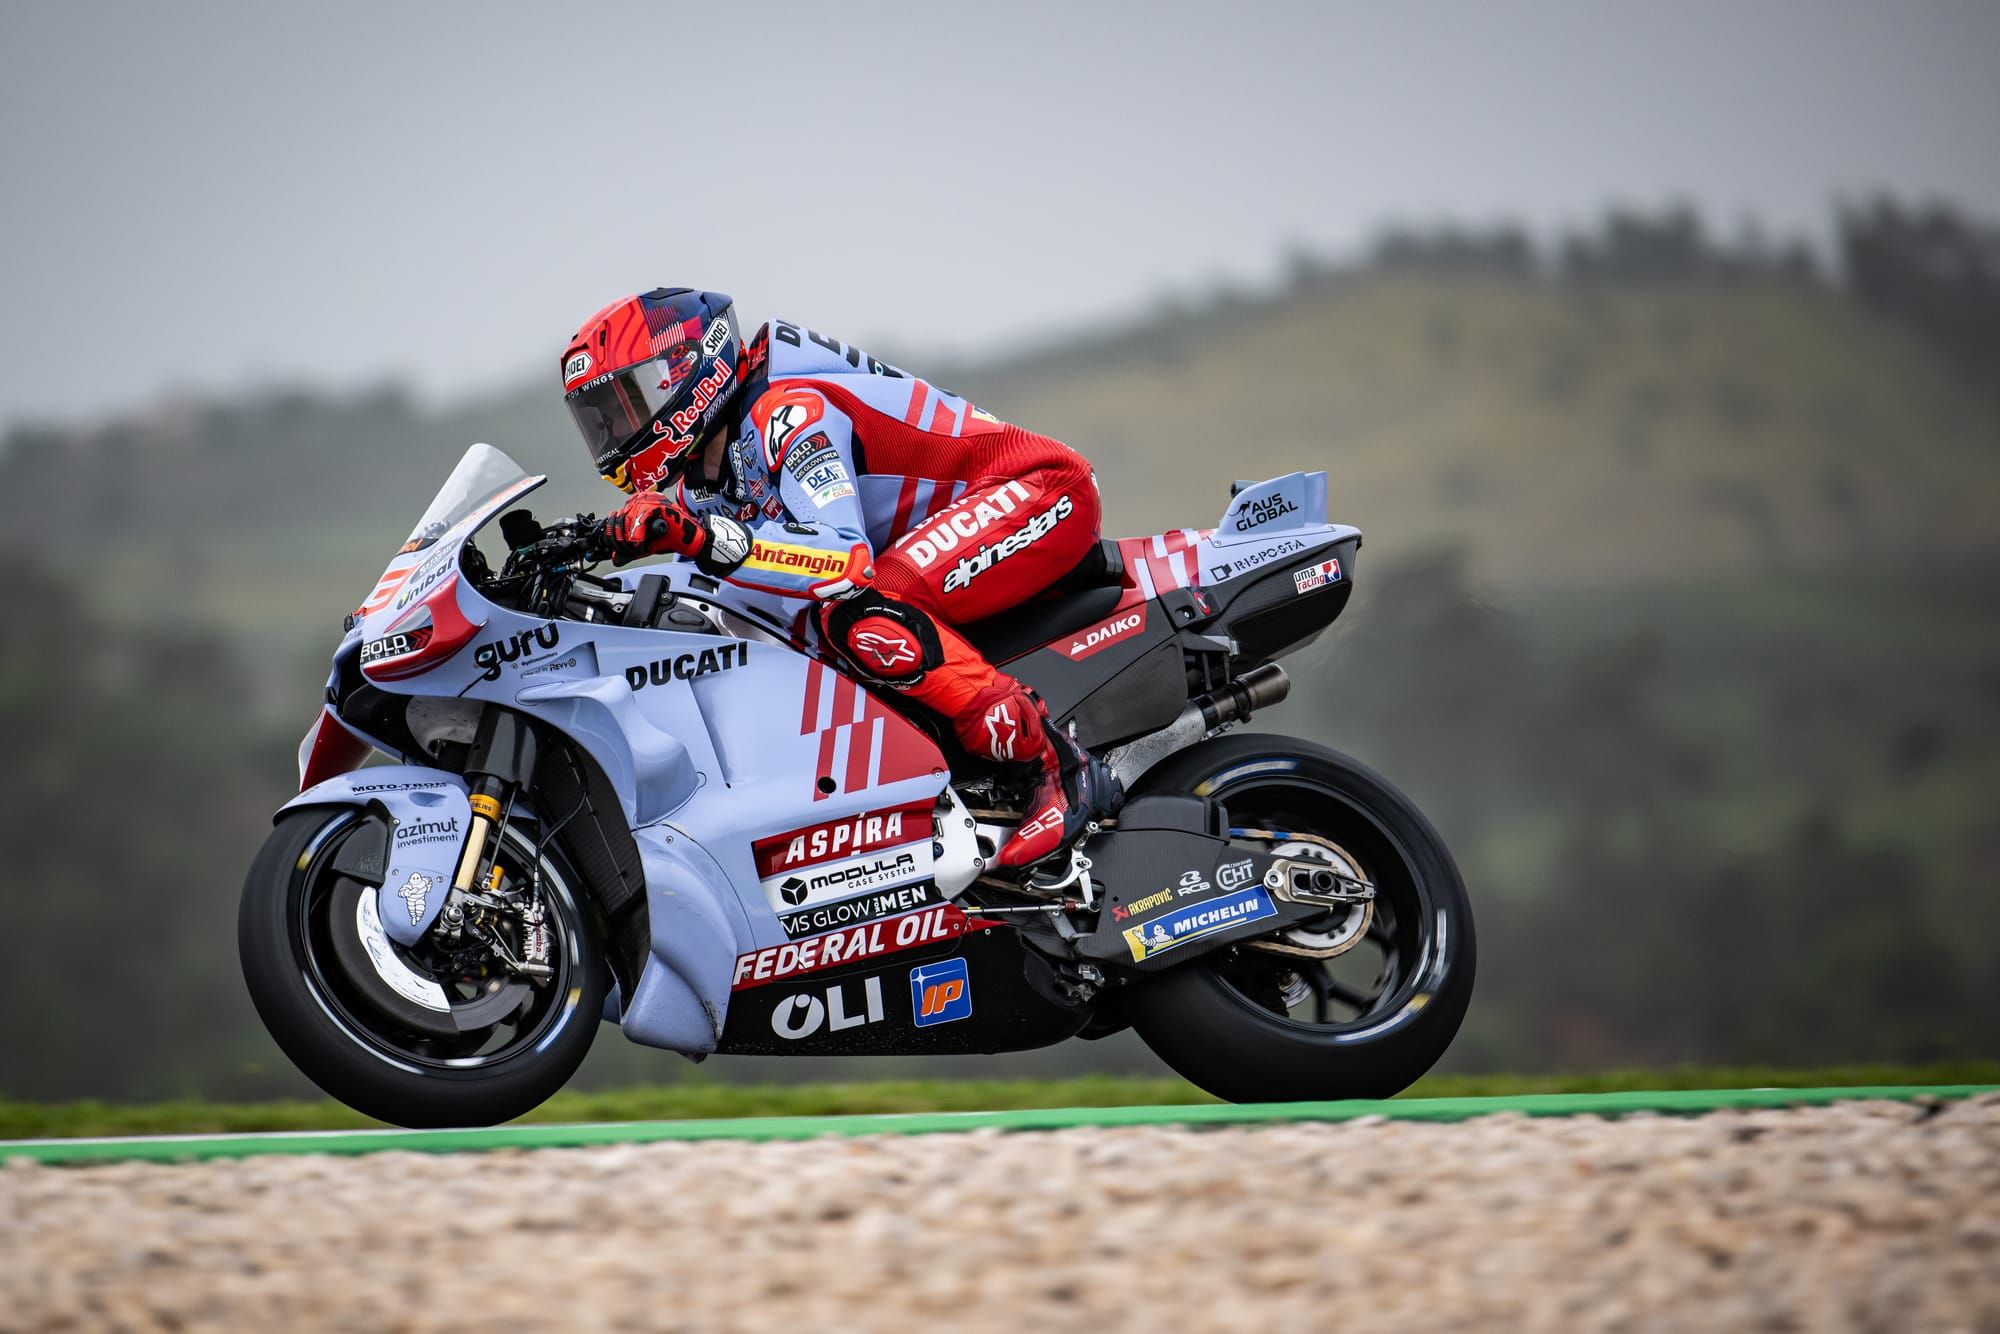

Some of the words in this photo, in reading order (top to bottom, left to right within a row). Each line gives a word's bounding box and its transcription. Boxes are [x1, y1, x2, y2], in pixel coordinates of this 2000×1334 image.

[706, 324, 728, 353] SHOEI
[566, 357, 585, 381] HOEI
[582, 372, 614, 392] WINGS
[670, 387, 710, 434] Red
[698, 357, 733, 401] Bull
[786, 441, 812, 468] BOLD
[807, 466, 837, 489] DEA
[1236, 501, 1298, 531] GLOBAL
[1252, 493, 1283, 514] AUS
[906, 480, 1031, 568] DUCATI
[750, 543, 845, 574] Antangin
[943, 495, 1073, 593] alpinestars
[1294, 567, 1316, 582] uma
[1298, 574, 1325, 591] racing
[360, 634, 407, 657] BOLD
[1086, 614, 1141, 647] DAIKO
[474, 622, 559, 681] guru
[626, 641, 748, 691] DUCATI
[396, 818, 459, 839] azimut
[397, 833, 458, 849] investimenti
[848, 877, 873, 889] CASE
[878, 865, 916, 882] SYSTEM
[814, 899, 871, 928] GLOW
[882, 884, 927, 913] MEN
[1174, 899, 1259, 935] MICHELIN
[733, 936, 885, 986] FEDERAL
[896, 908, 948, 947] OIL
[771, 976, 884, 1040] OLI
[921, 979, 964, 1017] IP
